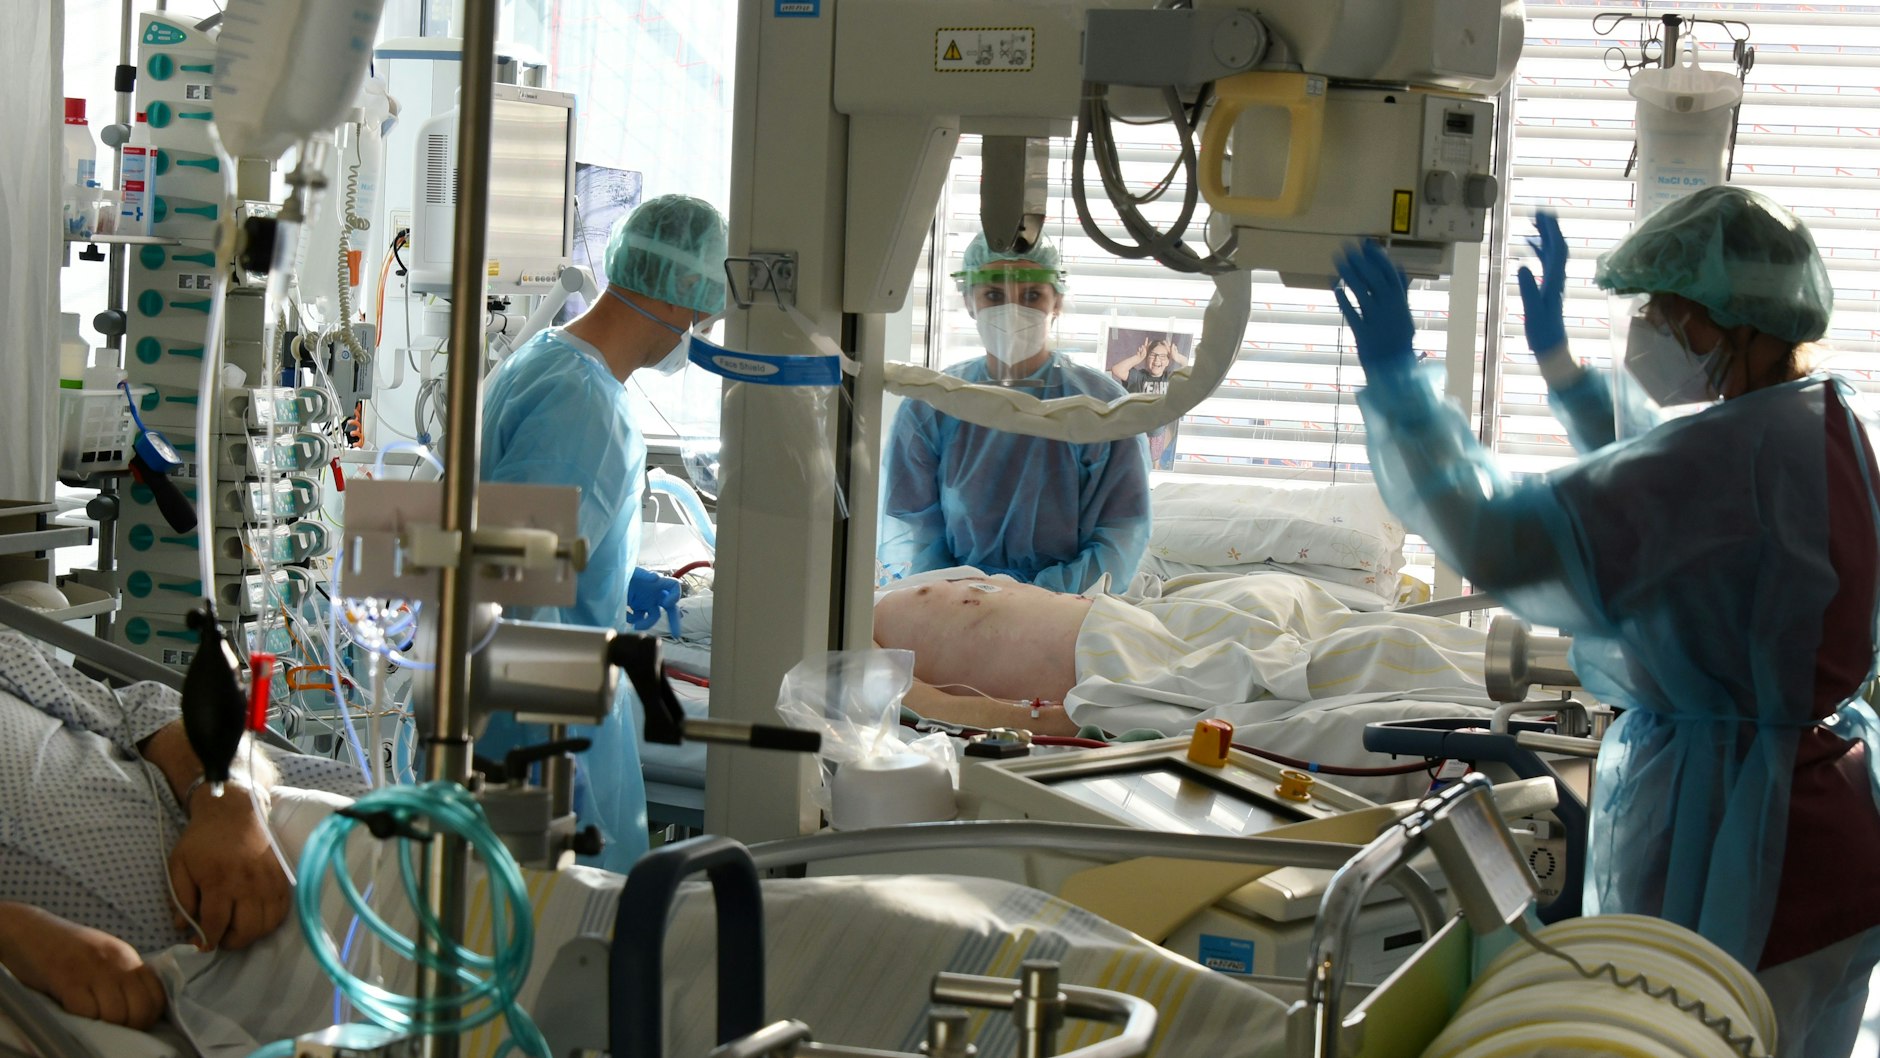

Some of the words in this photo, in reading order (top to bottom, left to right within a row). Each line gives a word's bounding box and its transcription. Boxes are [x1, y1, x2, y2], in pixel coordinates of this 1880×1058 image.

[1657, 176, 1680, 185] NaCl
[720, 357, 737, 368] Face
[739, 361, 765, 372] Shield
